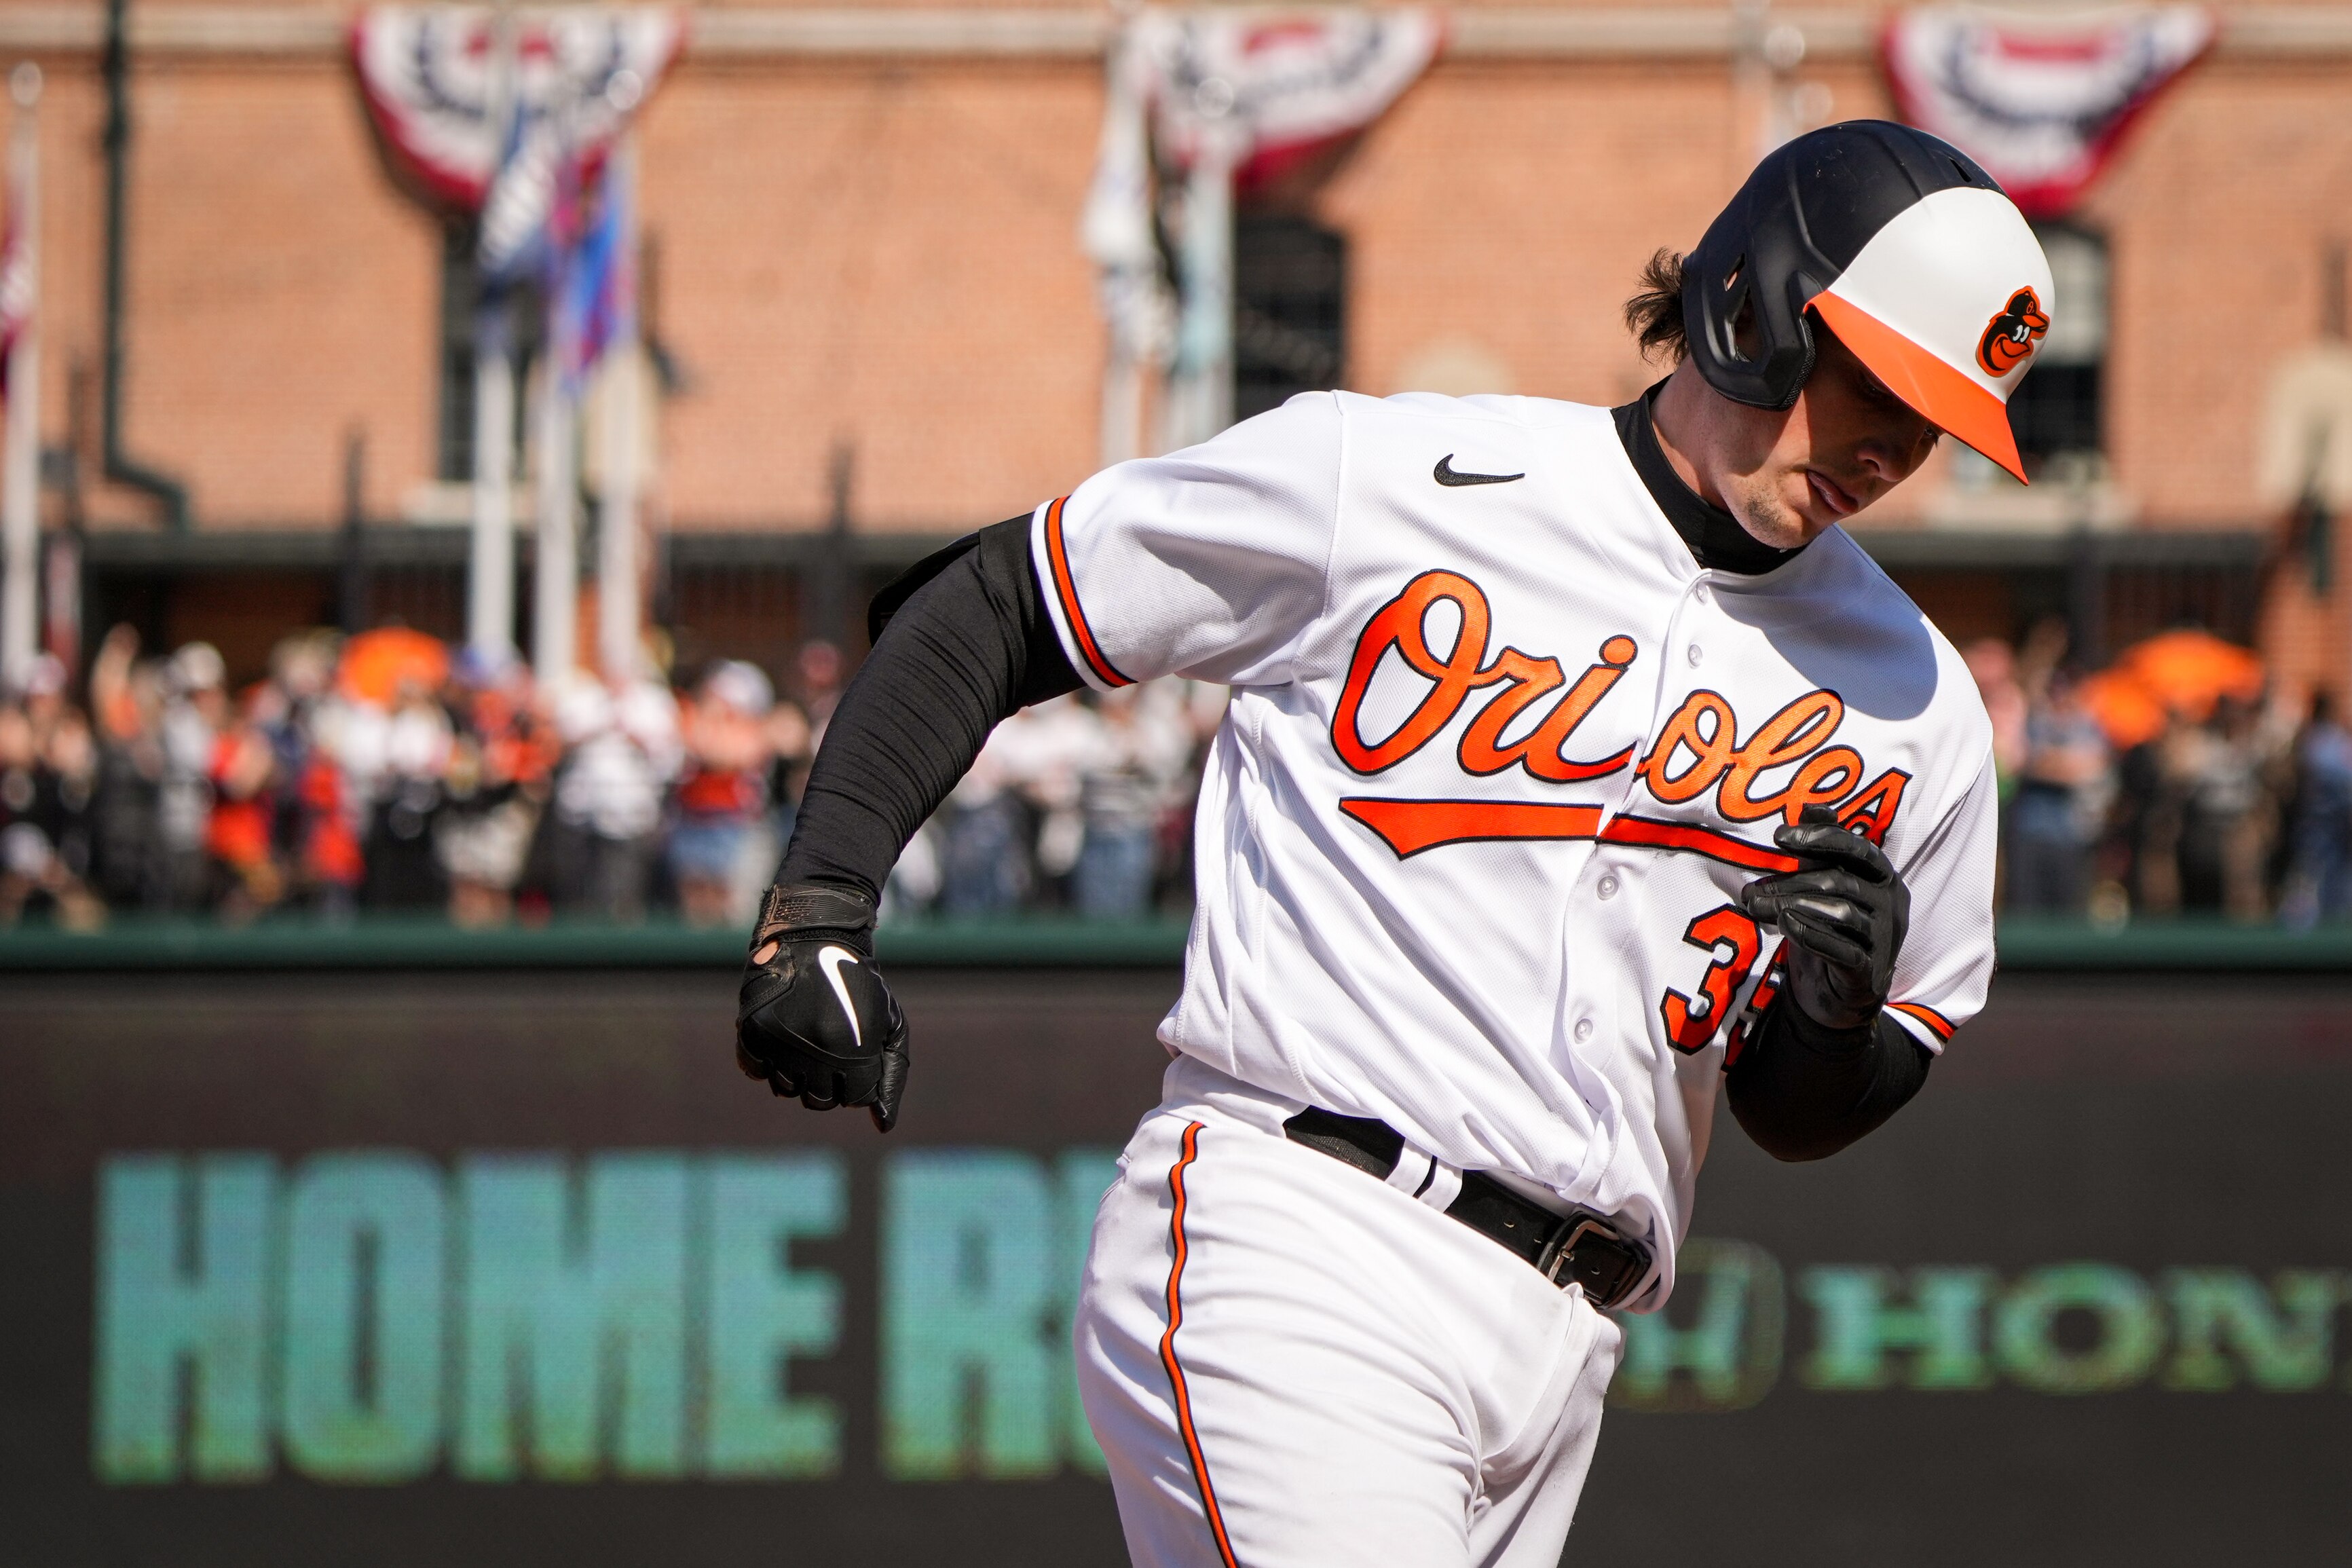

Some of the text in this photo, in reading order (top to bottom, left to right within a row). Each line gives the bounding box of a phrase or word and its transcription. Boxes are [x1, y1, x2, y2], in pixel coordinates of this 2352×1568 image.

[1331, 569, 1912, 848] Orioles
[95, 1153, 850, 1482] HOME
[1799, 1265, 2352, 1393] HON
